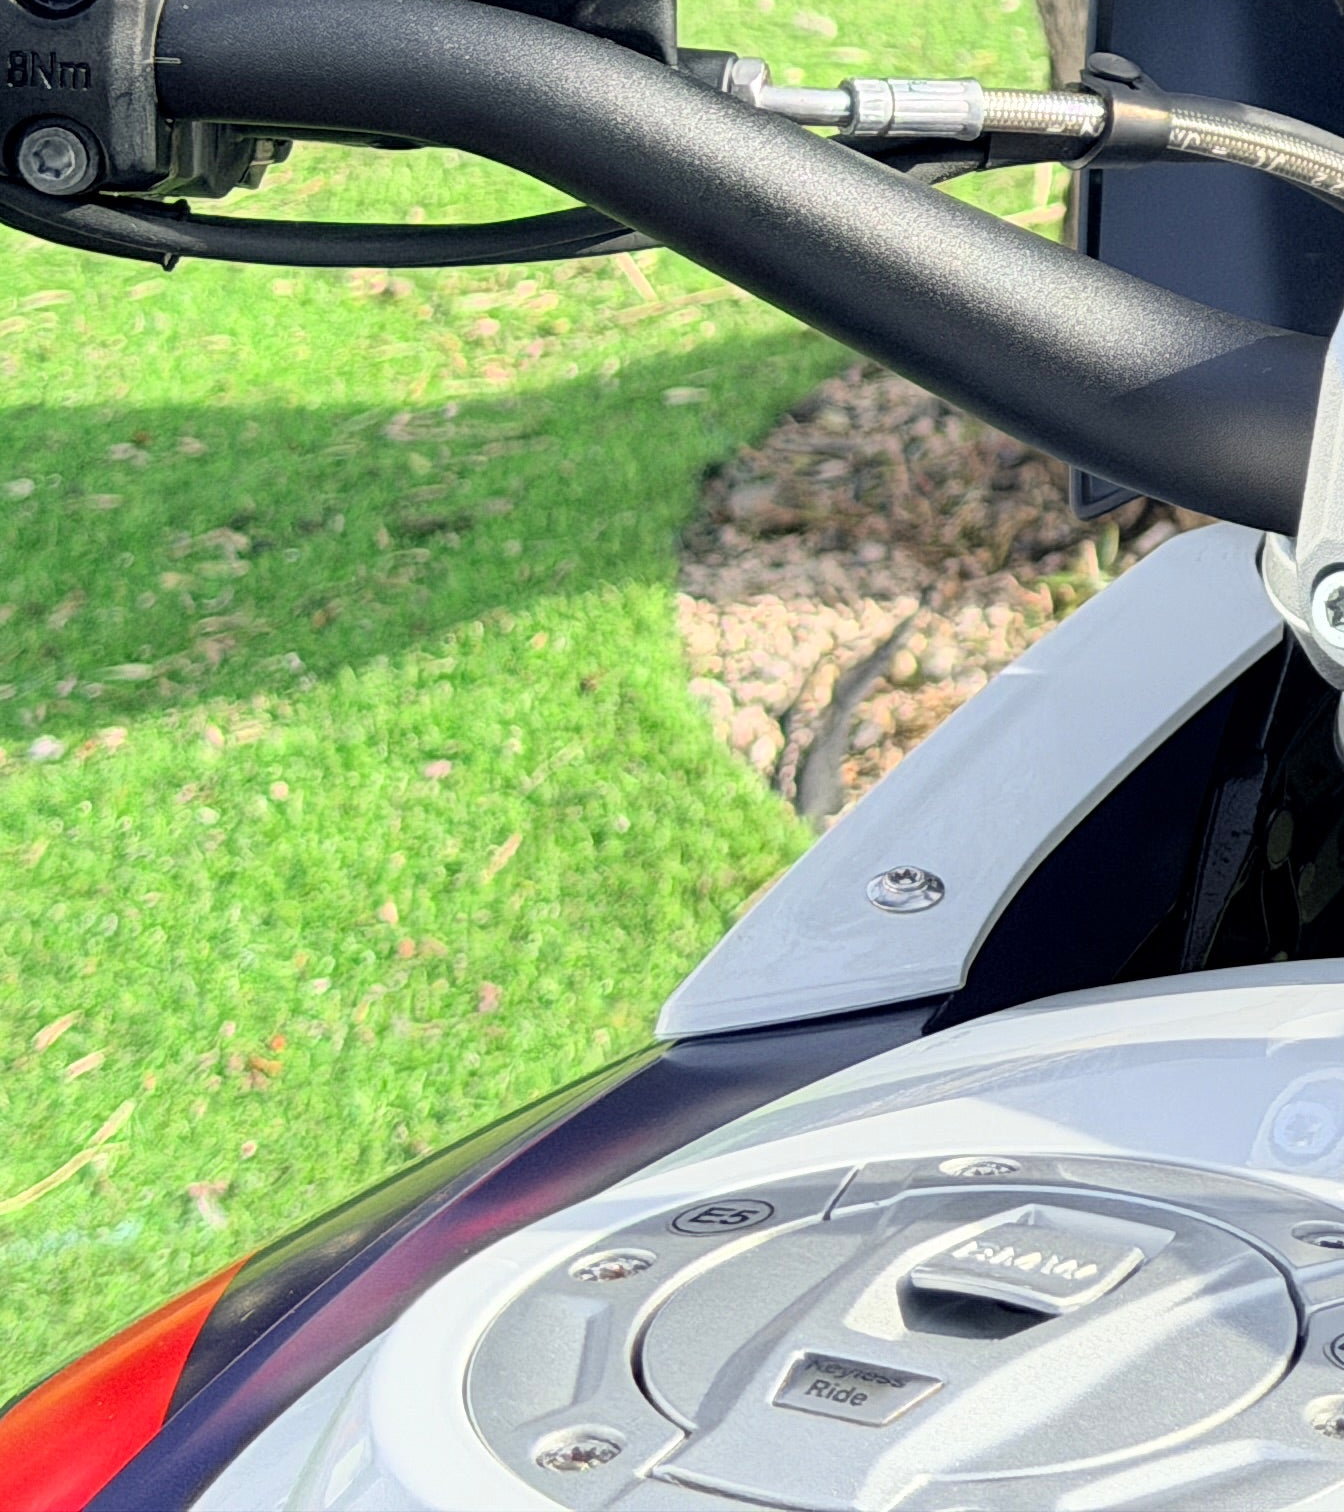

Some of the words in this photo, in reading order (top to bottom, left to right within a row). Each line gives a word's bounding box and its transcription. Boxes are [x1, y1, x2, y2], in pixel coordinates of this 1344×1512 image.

[8, 50, 92, 90] 8Nm
[688, 1205, 760, 1226] E5
[804, 1379, 868, 1406] Ride
